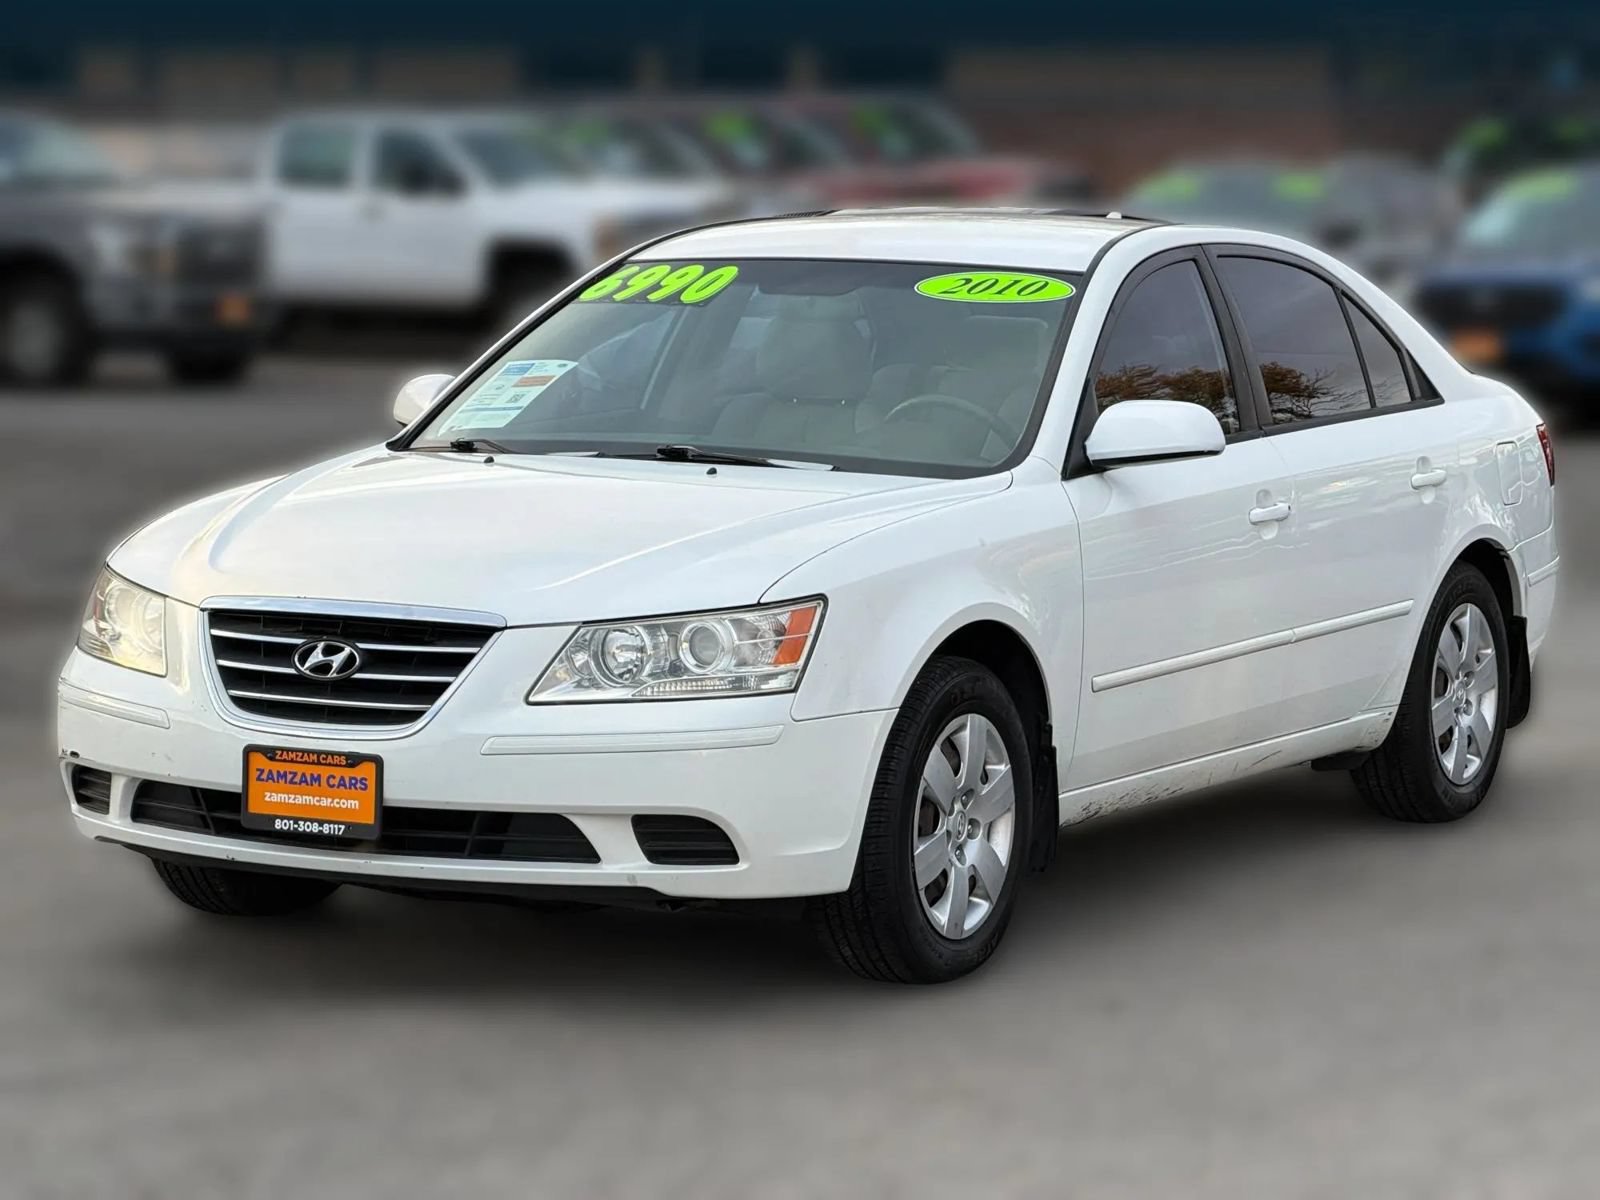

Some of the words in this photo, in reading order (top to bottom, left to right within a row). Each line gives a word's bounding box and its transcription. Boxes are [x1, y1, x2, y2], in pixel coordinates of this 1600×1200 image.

[578, 264, 739, 304] 6990
[937, 277, 1050, 297] 2010
[275, 750, 318, 763] ZAMZAM
[319, 755, 347, 766] CARS
[255, 768, 322, 787] ZAMZAM
[326, 774, 369, 791] CARS
[264, 792, 360, 810] zamzamcar.com
[274, 818, 346, 835] 801-308-8117
